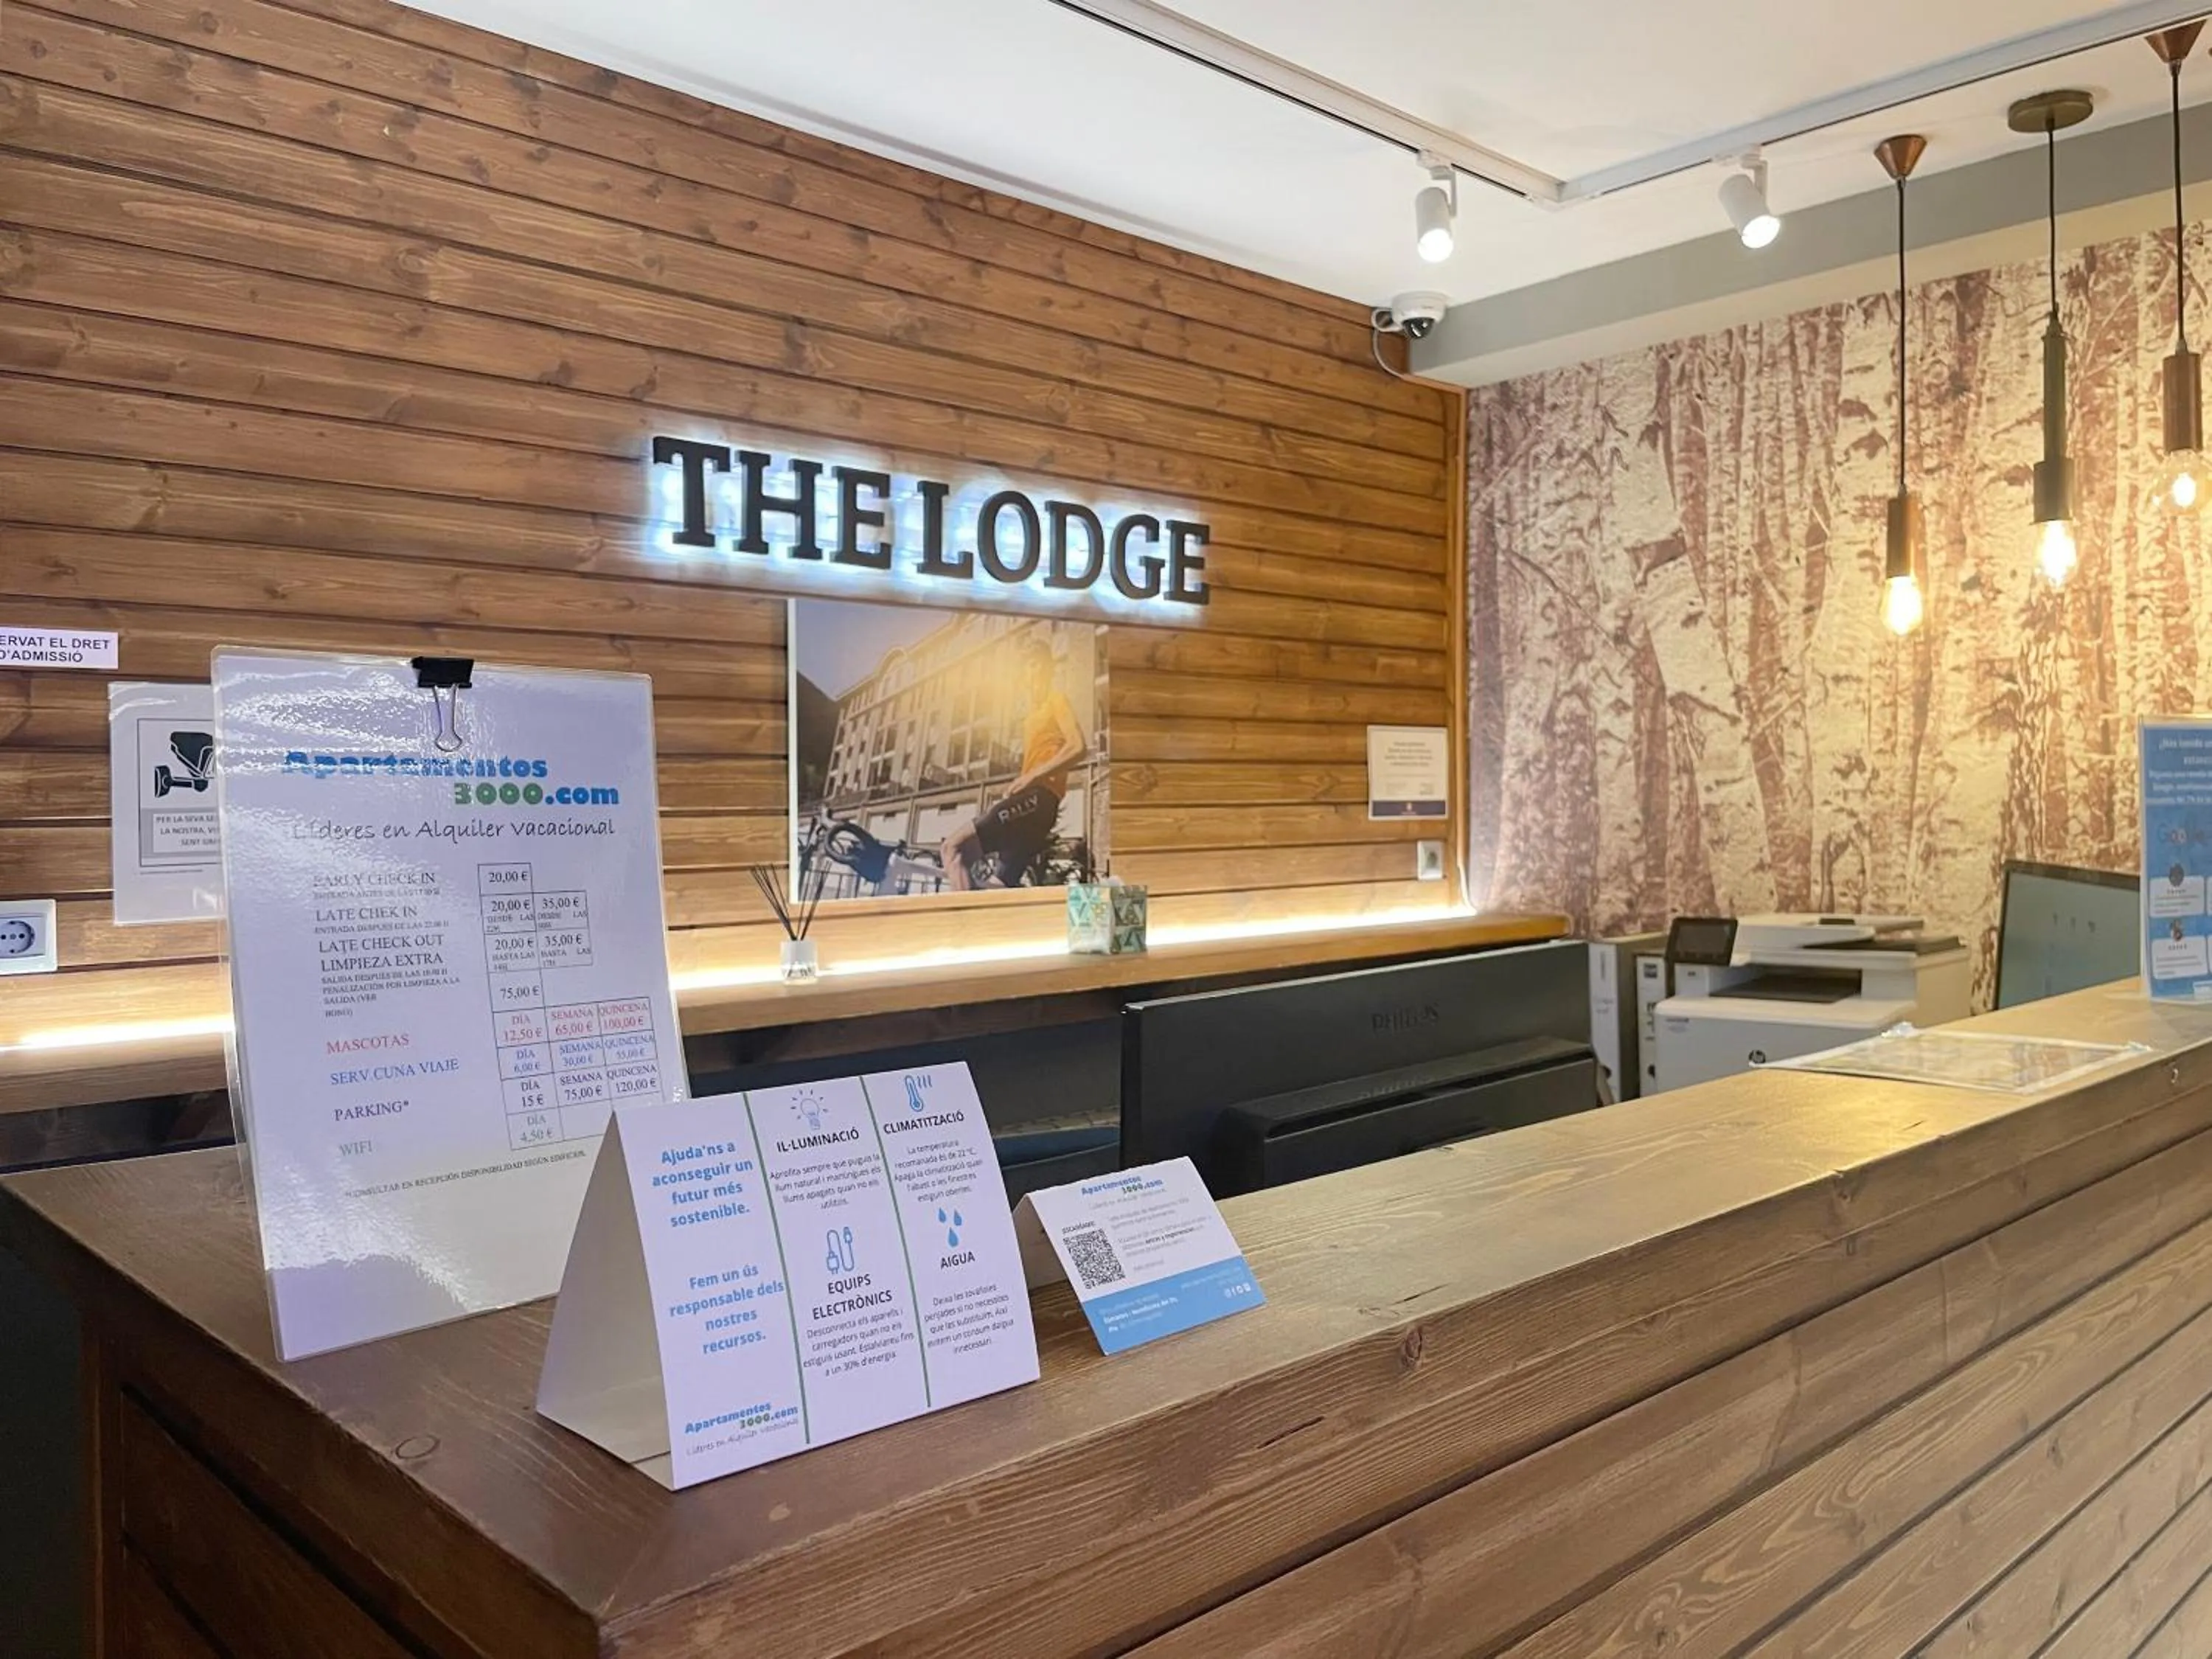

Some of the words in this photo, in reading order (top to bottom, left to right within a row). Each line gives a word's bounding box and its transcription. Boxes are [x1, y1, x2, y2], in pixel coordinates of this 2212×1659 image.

[653, 436, 891, 569] THE
[916, 480, 1210, 605] LODGE
[49, 637, 67, 648] EL
[72, 638, 110, 650] DRET
[0, 649, 83, 662] D'ADMISSIÓ
[282, 751, 548, 778] Apartamentos
[454, 782, 619, 805] 3000.com
[383, 824, 410, 838] en
[415, 819, 504, 844] Alquiler
[489, 871, 518, 884] 20,00
[521, 872, 528, 882] €
[316, 908, 355, 922] LATE
[358, 906, 399, 920] CHEK
[403, 905, 418, 918] IN
[490, 899, 521, 913] 20,00
[524, 899, 531, 910] €
[543, 897, 571, 910] 35,00
[573, 896, 580, 907] €
[319, 938, 359, 954] LATE
[361, 935, 411, 950] CHECK
[415, 933, 444, 947] OUT
[495, 938, 525, 951] 20,00
[527, 938, 535, 948] €
[545, 934, 573, 947] 35,00
[576, 933, 583, 945] €
[321, 956, 392, 973] LIMPIEZA
[395, 953, 443, 967] EXTRA
[500, 986, 530, 1001] 75,00
[532, 985, 540, 996] €
[511, 1014, 532, 1026] DÍA
[551, 1008, 594, 1021] SEMANA
[599, 1003, 648, 1017] QUINCENA
[504, 1029, 533, 1042] 12,50
[535, 1028, 543, 1040] €
[555, 1022, 585, 1037] 65,00
[586, 1021, 593, 1033] €
[603, 1017, 636, 1031] 100,00
[638, 1015, 644, 1026] €
[326, 1033, 410, 1055] MASCOTAS
[517, 1048, 535, 1060] DÍA
[559, 1041, 603, 1055] SEMANA
[419, 1057, 459, 1074] VIAJE
[521, 1079, 540, 1092] DÍA
[560, 1071, 602, 1086] SEMANA
[606, 1065, 657, 1081] QUINCENA
[521, 1094, 535, 1107] 15
[536, 1093, 544, 1106] €
[564, 1085, 594, 1101] 75,00
[595, 1084, 603, 1096] €
[615, 1079, 648, 1093] 120,00
[650, 1077, 657, 1088] €
[526, 1114, 546, 1127] DÍA
[883, 1109, 965, 1135] CLIMATITZACIÓ
[520, 1128, 545, 1144] 4,50
[546, 1127, 554, 1139] €
[776, 1126, 860, 1153] IL·LUMINACIÓ
[338, 1141, 373, 1157] WIFI
[661, 1144, 724, 1166] Ajuda'ns
[727, 1142, 737, 1152] a
[653, 1163, 731, 1187] aconseguir
[735, 1160, 754, 1172] un
[672, 1189, 710, 1206] futur
[713, 1181, 743, 1198] més
[670, 1203, 751, 1228] sostenible.
[939, 1251, 975, 1270] AIGUA
[689, 1273, 719, 1290] Fem
[722, 1268, 740, 1282] un
[742, 1264, 759, 1277] ús
[827, 1273, 872, 1295] EQUIPS
[669, 1287, 753, 1317] responsable
[757, 1280, 785, 1297] dels
[812, 1290, 893, 1320] ELECTRÒNICS
[704, 1309, 757, 1331] nostres
[702, 1330, 767, 1354] recursos.
[685, 1402, 772, 1434] Apartamentos
